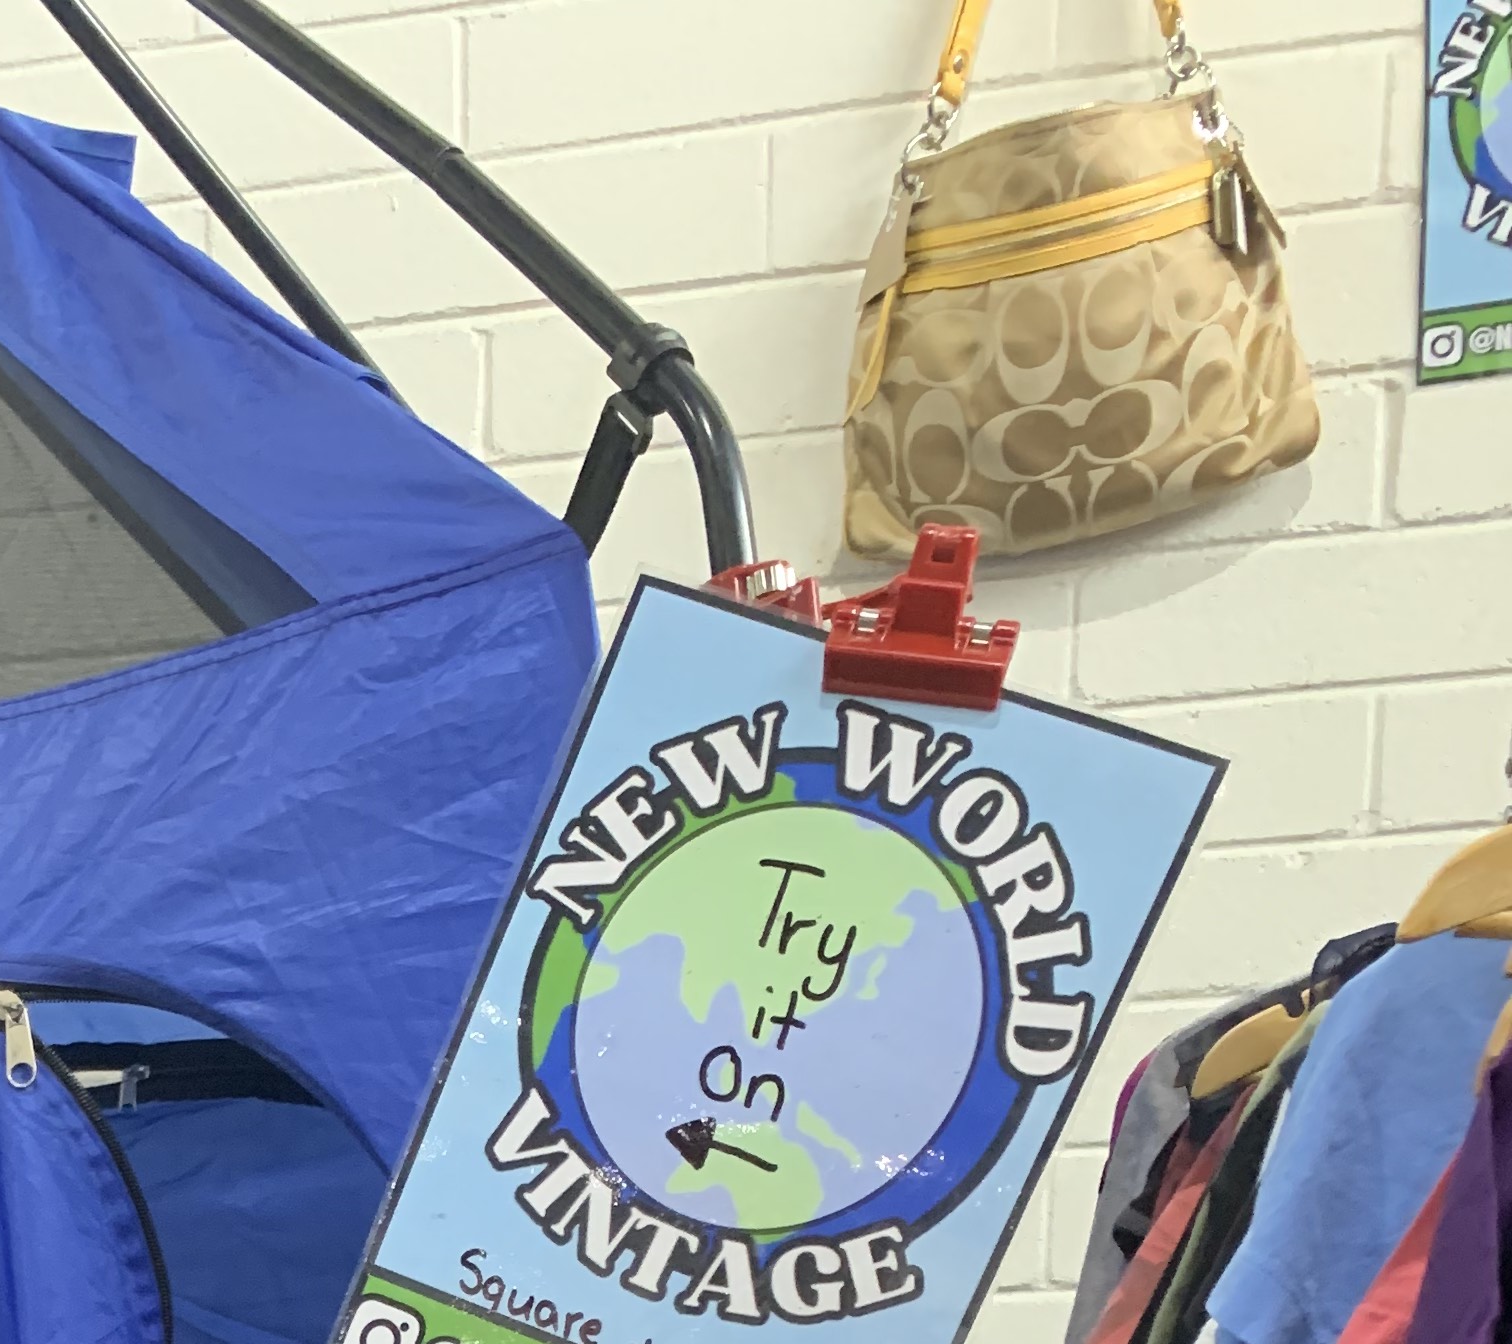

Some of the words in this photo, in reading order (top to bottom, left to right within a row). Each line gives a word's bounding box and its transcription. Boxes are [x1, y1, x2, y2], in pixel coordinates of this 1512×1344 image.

[529, 704, 787, 929] NEW
[838, 703, 1091, 1081] WORLD
[758, 858, 857, 1001] Try
[699, 1044, 786, 1122] On
[752, 985, 806, 1051] it
[488, 1087, 920, 1321] VINTAGE
